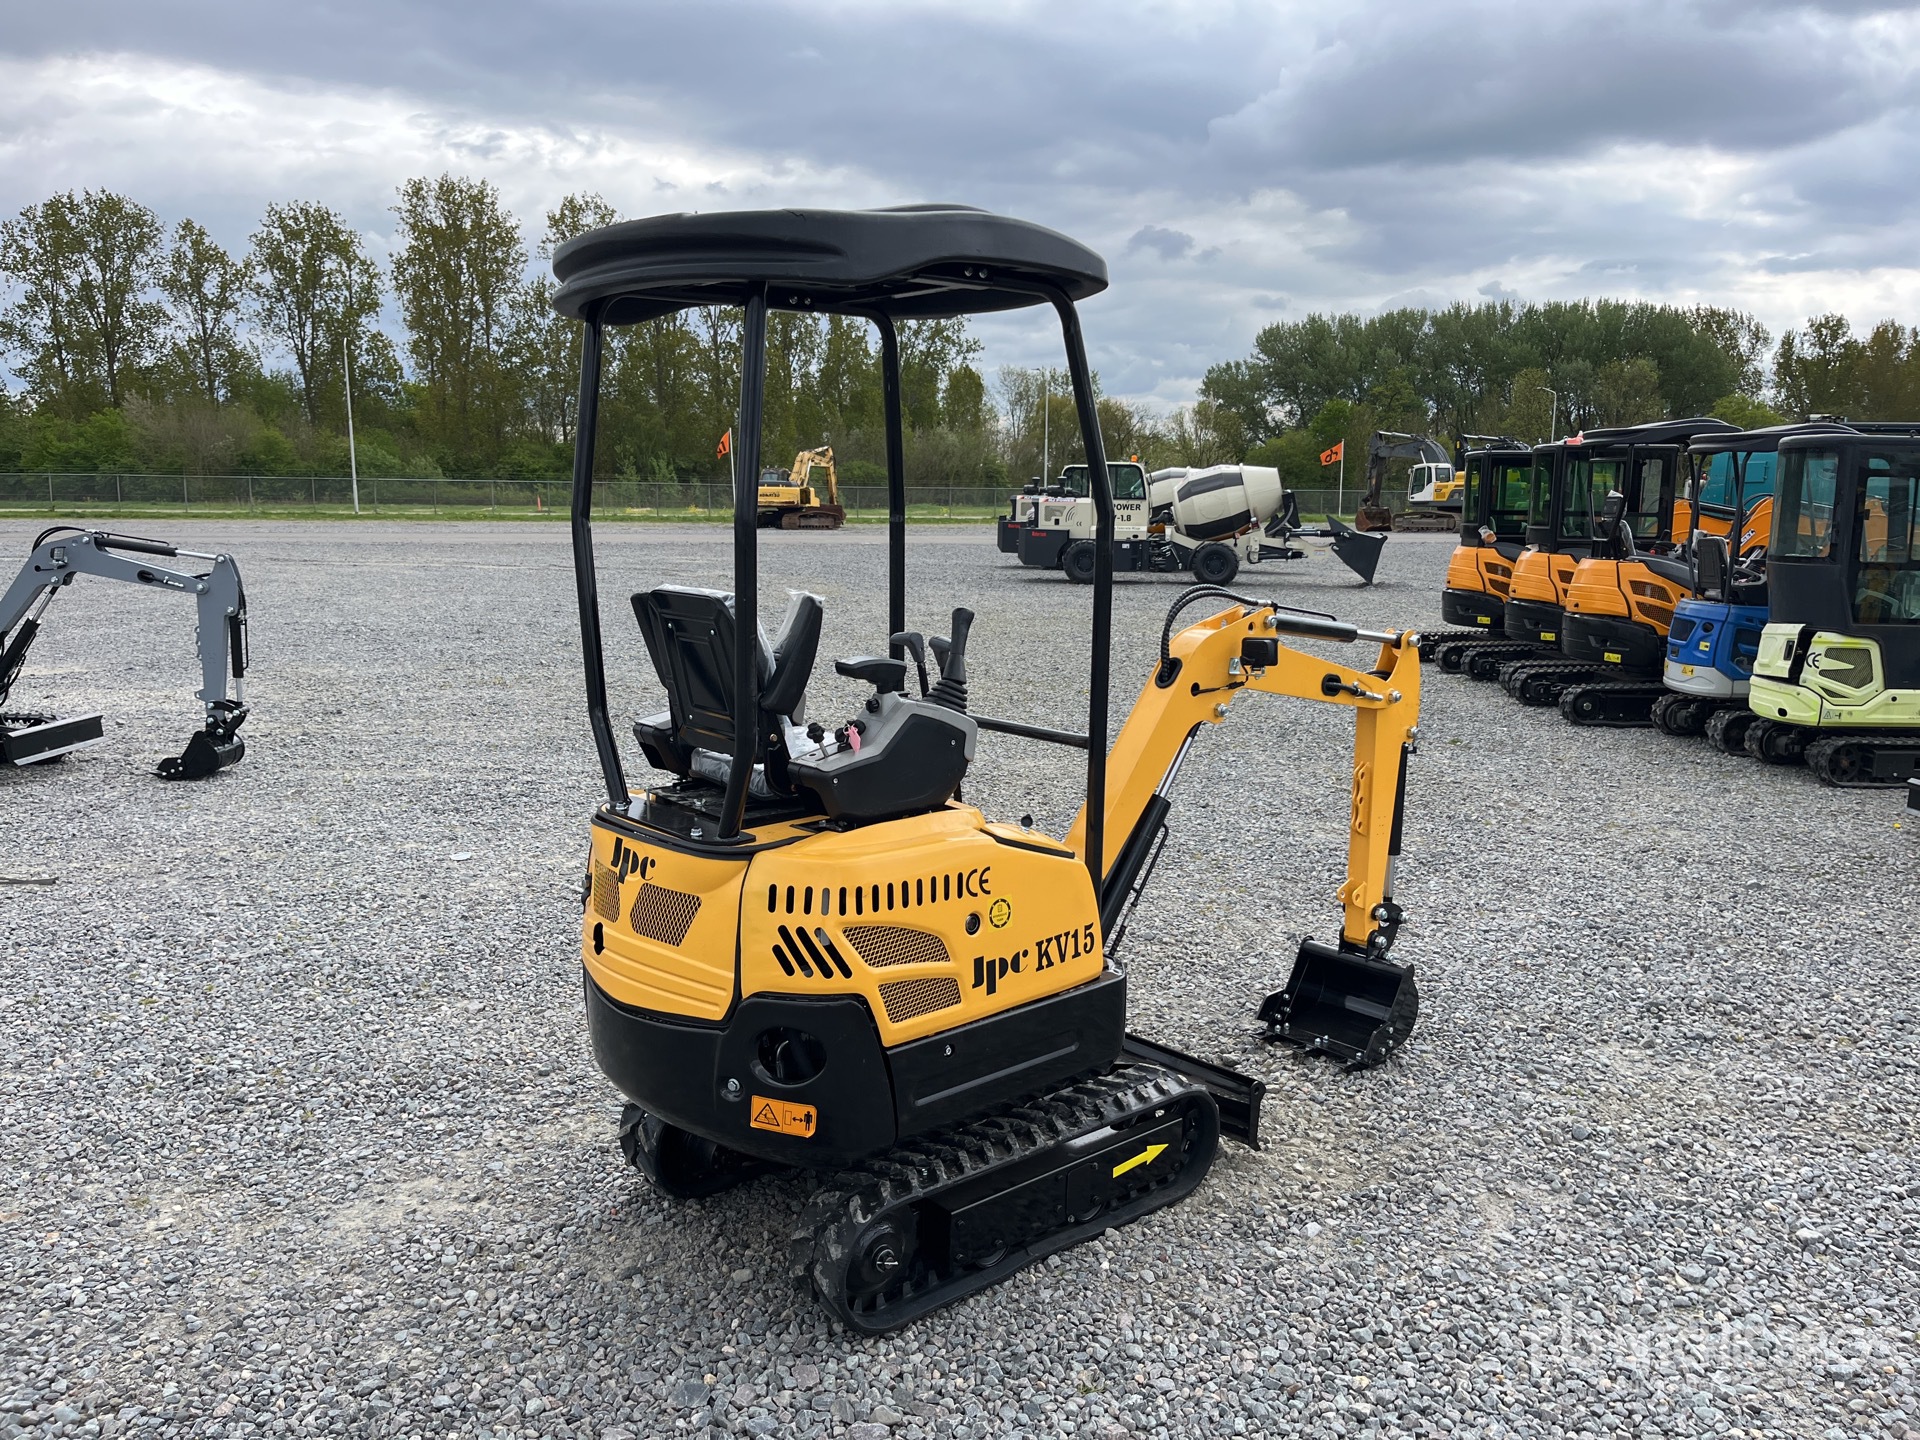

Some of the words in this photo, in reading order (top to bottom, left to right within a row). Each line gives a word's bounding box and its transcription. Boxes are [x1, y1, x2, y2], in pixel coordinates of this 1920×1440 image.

[1806, 652, 1822, 669] CE
[966, 866, 991, 898] CE
[1035, 922, 1095, 973] KV15
